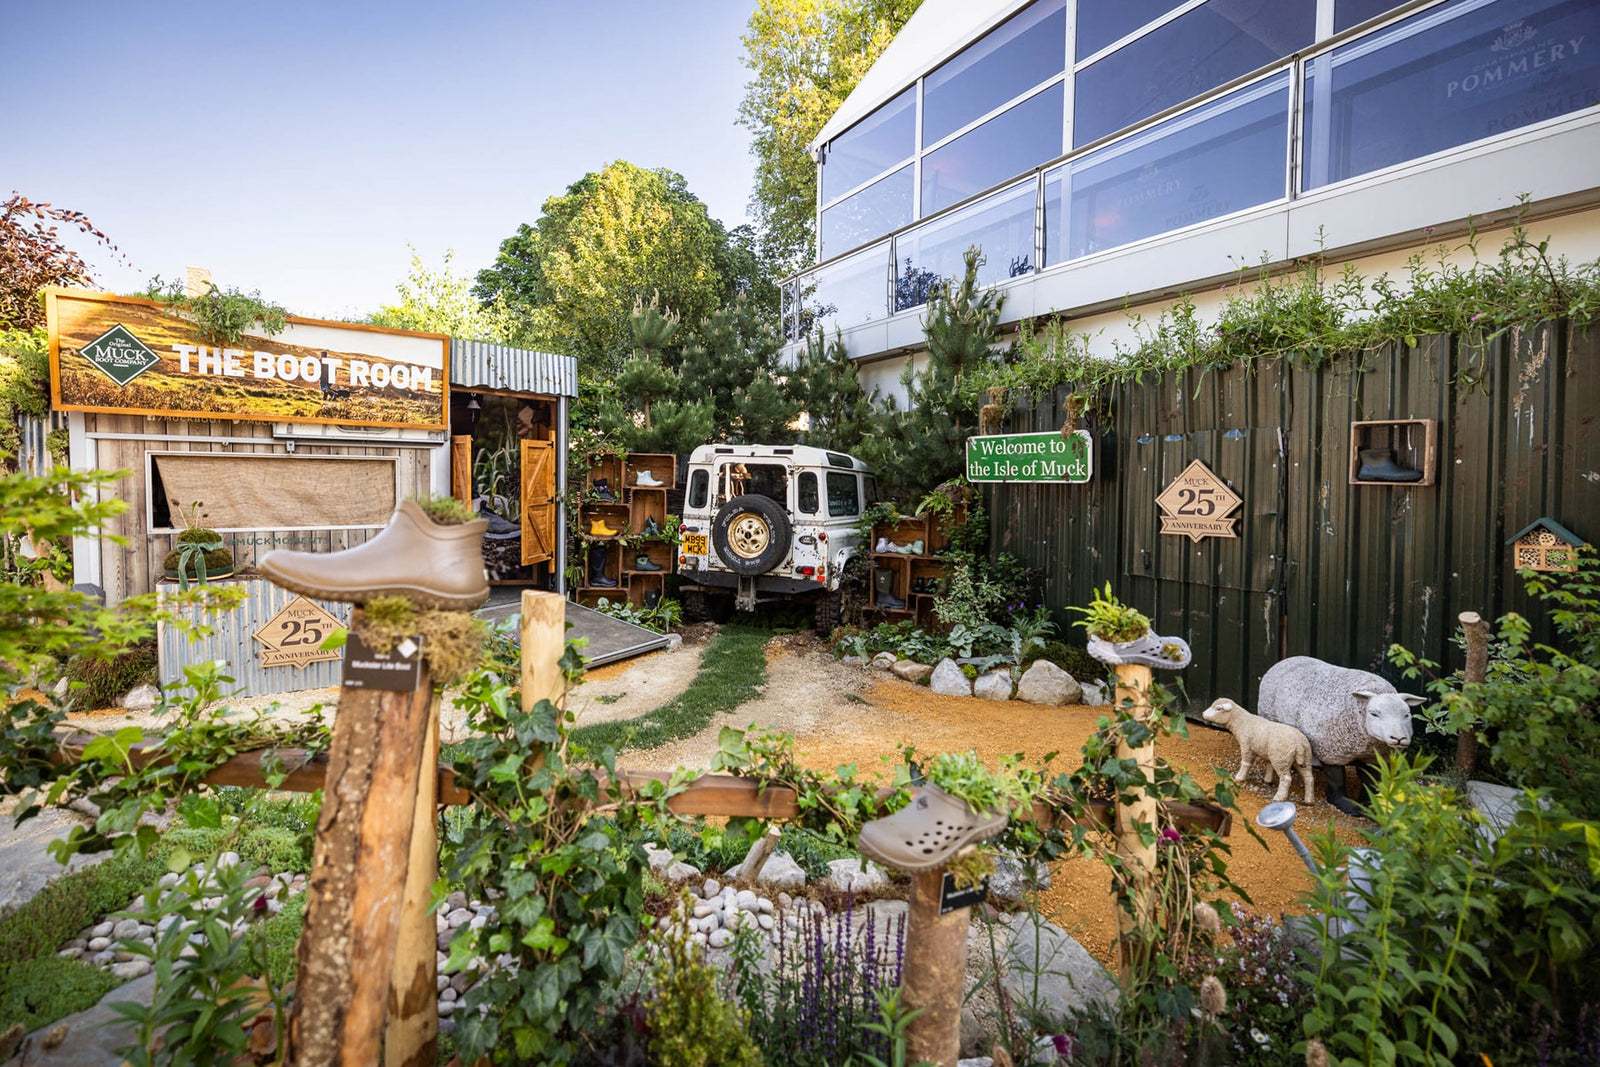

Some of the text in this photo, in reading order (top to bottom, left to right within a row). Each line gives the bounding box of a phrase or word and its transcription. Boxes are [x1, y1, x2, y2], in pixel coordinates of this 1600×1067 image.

[1447, 35, 1585, 98] POMMERY
[95, 345, 147, 361] MUCK
[114, 358, 147, 366] COMPANY
[172, 343, 432, 392] THE BOOT ROOM
[980, 438, 1066, 456] Welcome to
[969, 458, 1087, 477] the Isle of Muck
[1184, 478, 1210, 486] MUCK
[1170, 522, 1223, 531] ANNIVERSARY
[287, 609, 316, 617] MUCK
[272, 650, 331, 661] ANNIVERSARY
